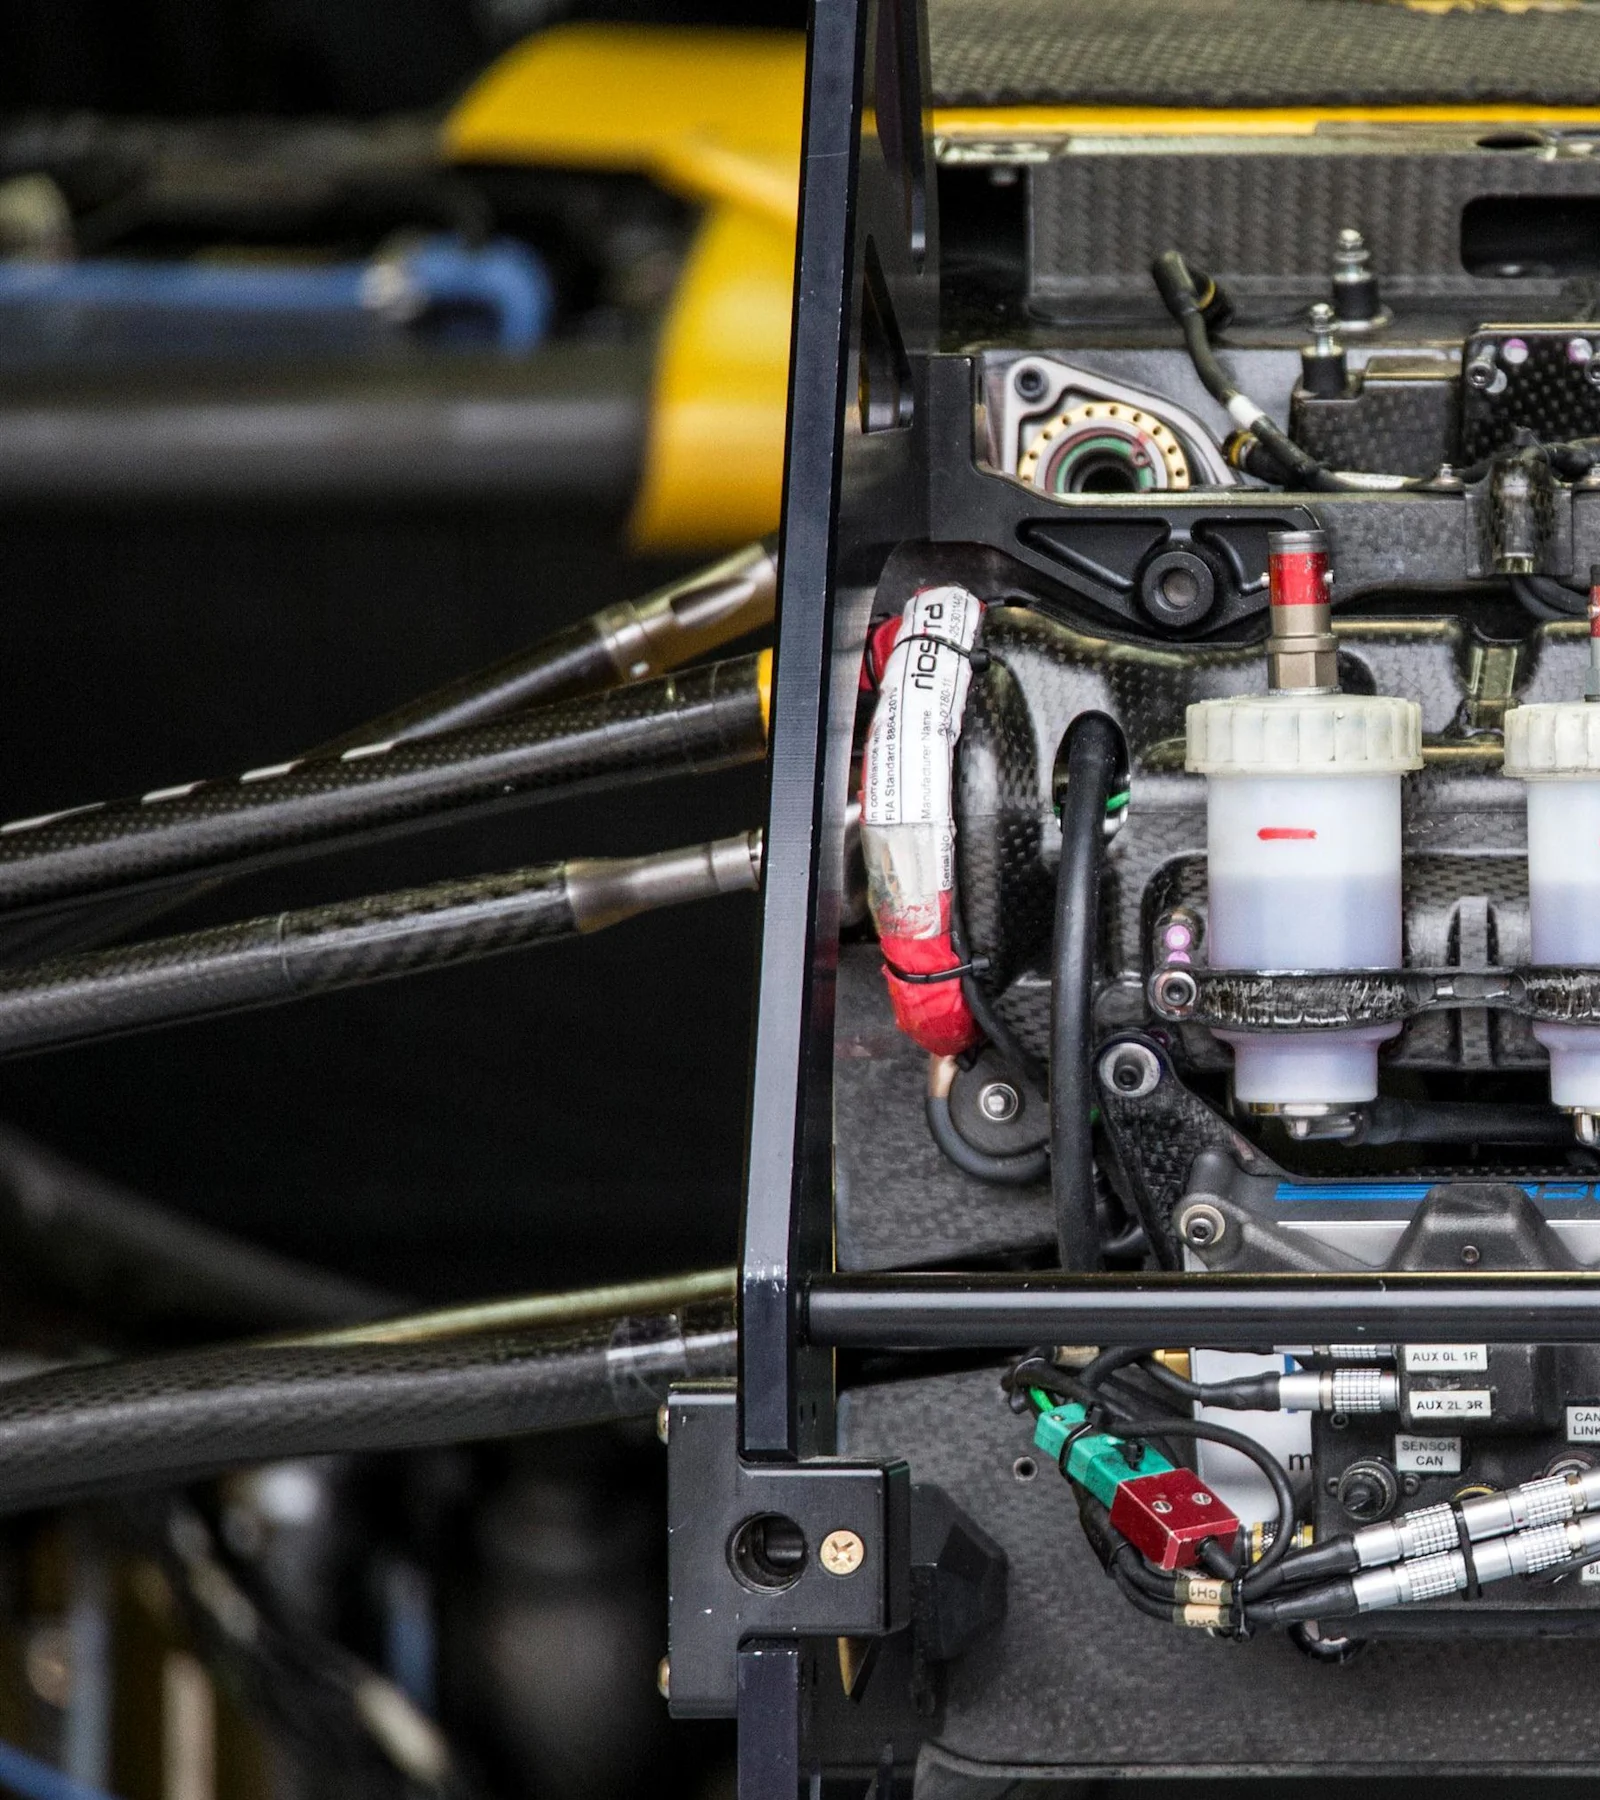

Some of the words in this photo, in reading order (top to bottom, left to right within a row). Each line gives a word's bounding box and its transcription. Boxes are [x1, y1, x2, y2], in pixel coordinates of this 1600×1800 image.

[911, 603, 944, 690] riosra
[885, 744, 896, 798] Standard
[921, 747, 933, 820] Manufacturer
[885, 801, 895, 821] FIA
[942, 854, 951, 888] Serial
[1412, 1352, 1440, 1362] AUX
[1463, 1352, 1479, 1361] 1R
[1416, 1400, 1443, 1410] AUX
[1447, 1400, 1462, 1410] 2L
[1467, 1400, 1483, 1410] 3R
[1401, 1440, 1457, 1452] SENSOR
[1416, 1455, 1444, 1466] CAN
[1191, 1587, 1218, 1600] CH1
